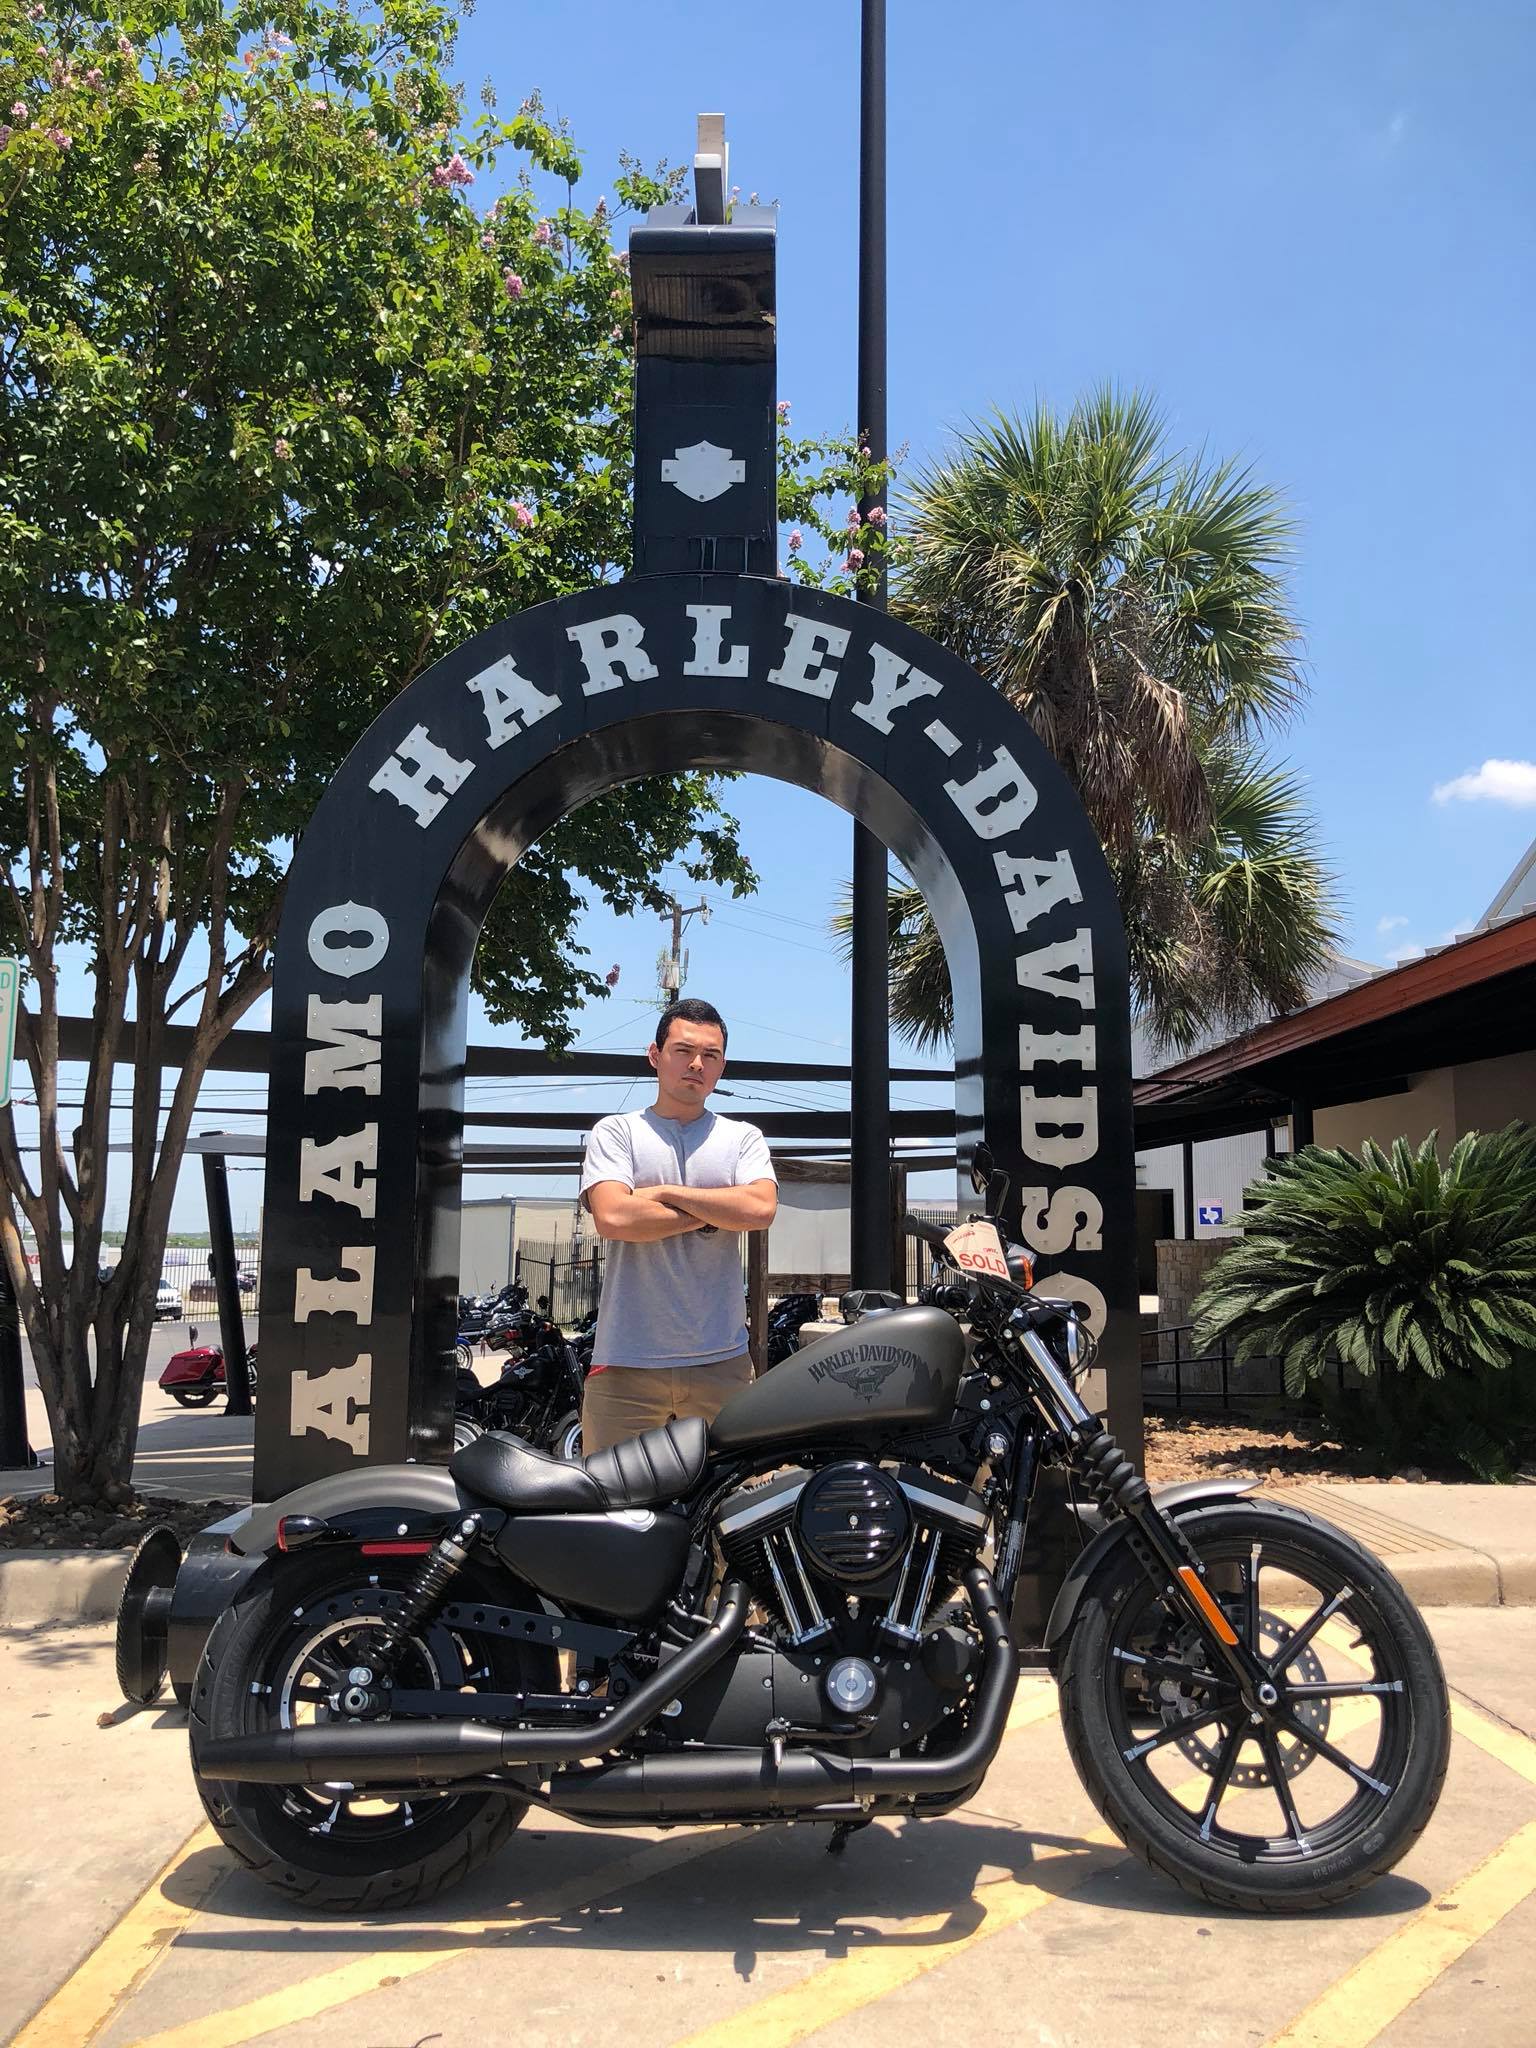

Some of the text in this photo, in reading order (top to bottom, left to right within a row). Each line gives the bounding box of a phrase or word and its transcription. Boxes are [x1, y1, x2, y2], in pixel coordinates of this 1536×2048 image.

[290, 603, 1109, 1456] ALAMO HARLEY-DAVIDSO
[959, 1253, 1007, 1275] SOLD
